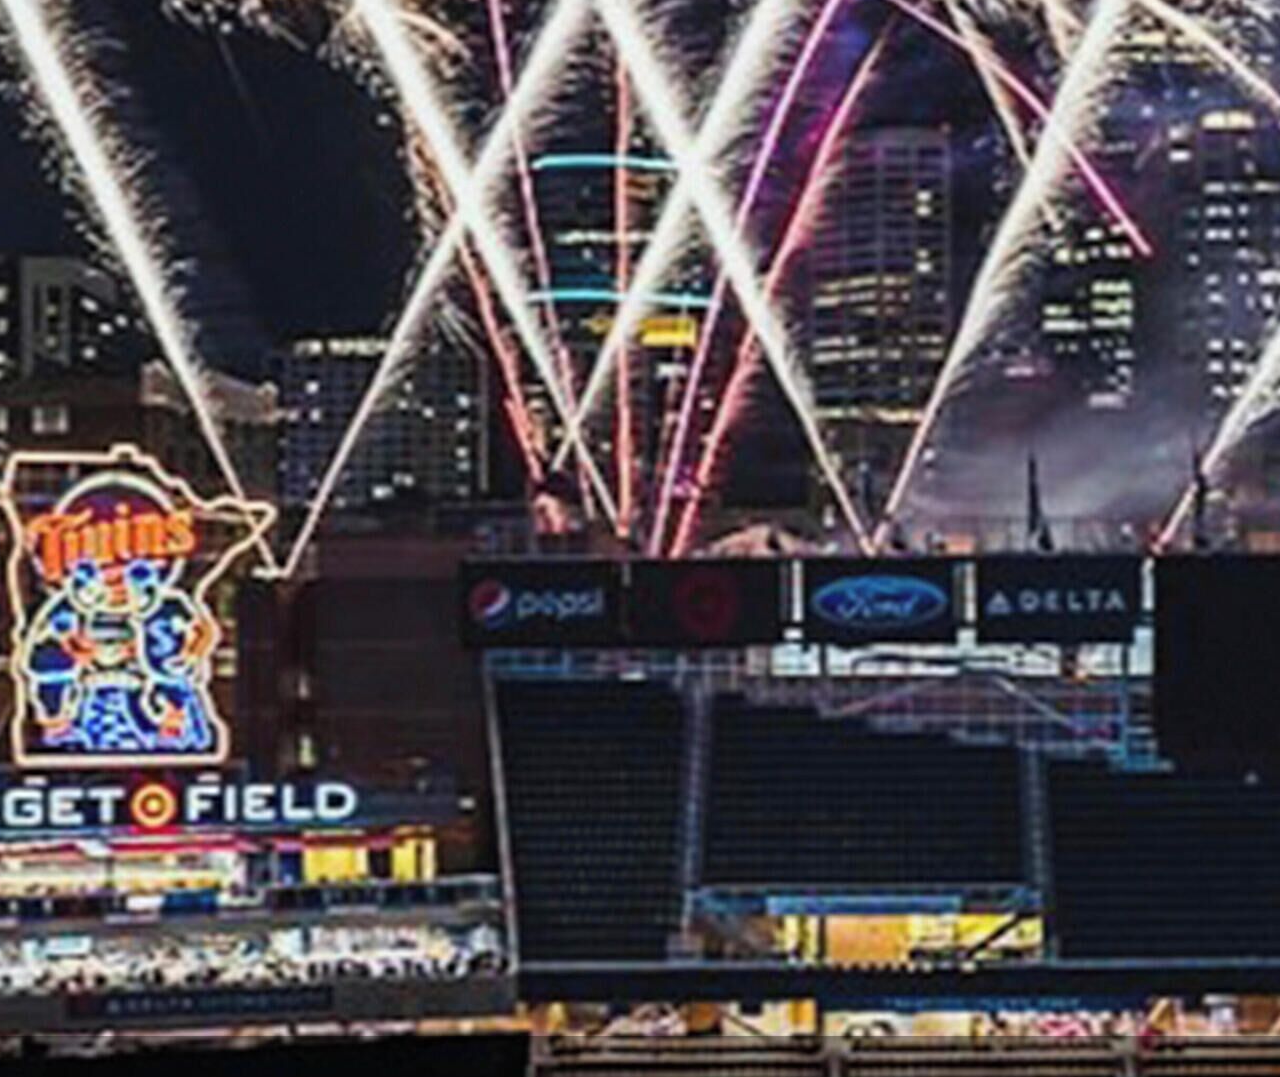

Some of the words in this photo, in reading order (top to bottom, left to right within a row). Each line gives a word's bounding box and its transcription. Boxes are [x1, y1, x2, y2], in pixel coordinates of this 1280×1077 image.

[25, 502, 196, 581] Twins
[517, 588, 604, 619] pepsi
[836, 590, 918, 619] Ford
[1020, 589, 1127, 612] DELTA
[186, 782, 357, 822] FIELD
